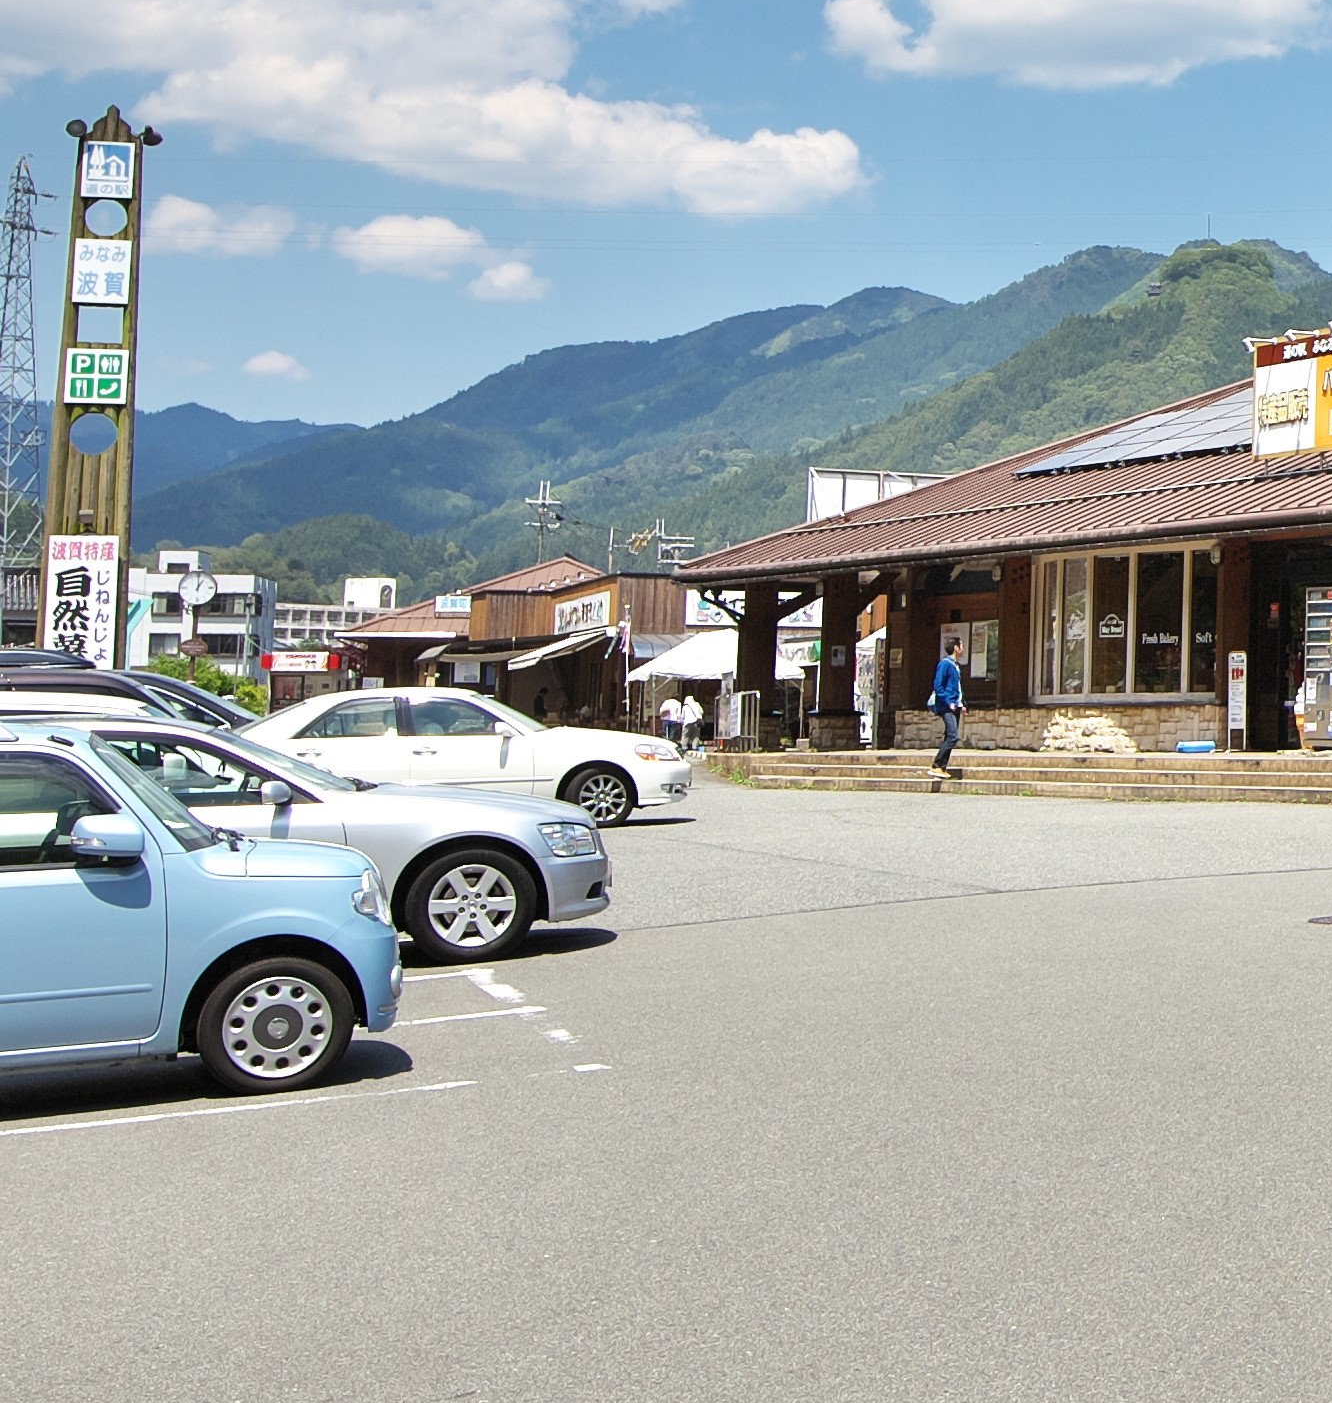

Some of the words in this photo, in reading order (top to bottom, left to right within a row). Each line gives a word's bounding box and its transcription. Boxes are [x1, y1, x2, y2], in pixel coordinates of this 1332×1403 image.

[85, 183, 129, 195] 道の駅
[79, 244, 126, 263] みなみ
[77, 270, 125, 297] 波賀
[52, 541, 115, 561] 波賀特産
[1142, 633, 1158, 645] Fresh
[1159, 633, 1179, 646] Bakery
[1195, 632, 1213, 644] Soft
